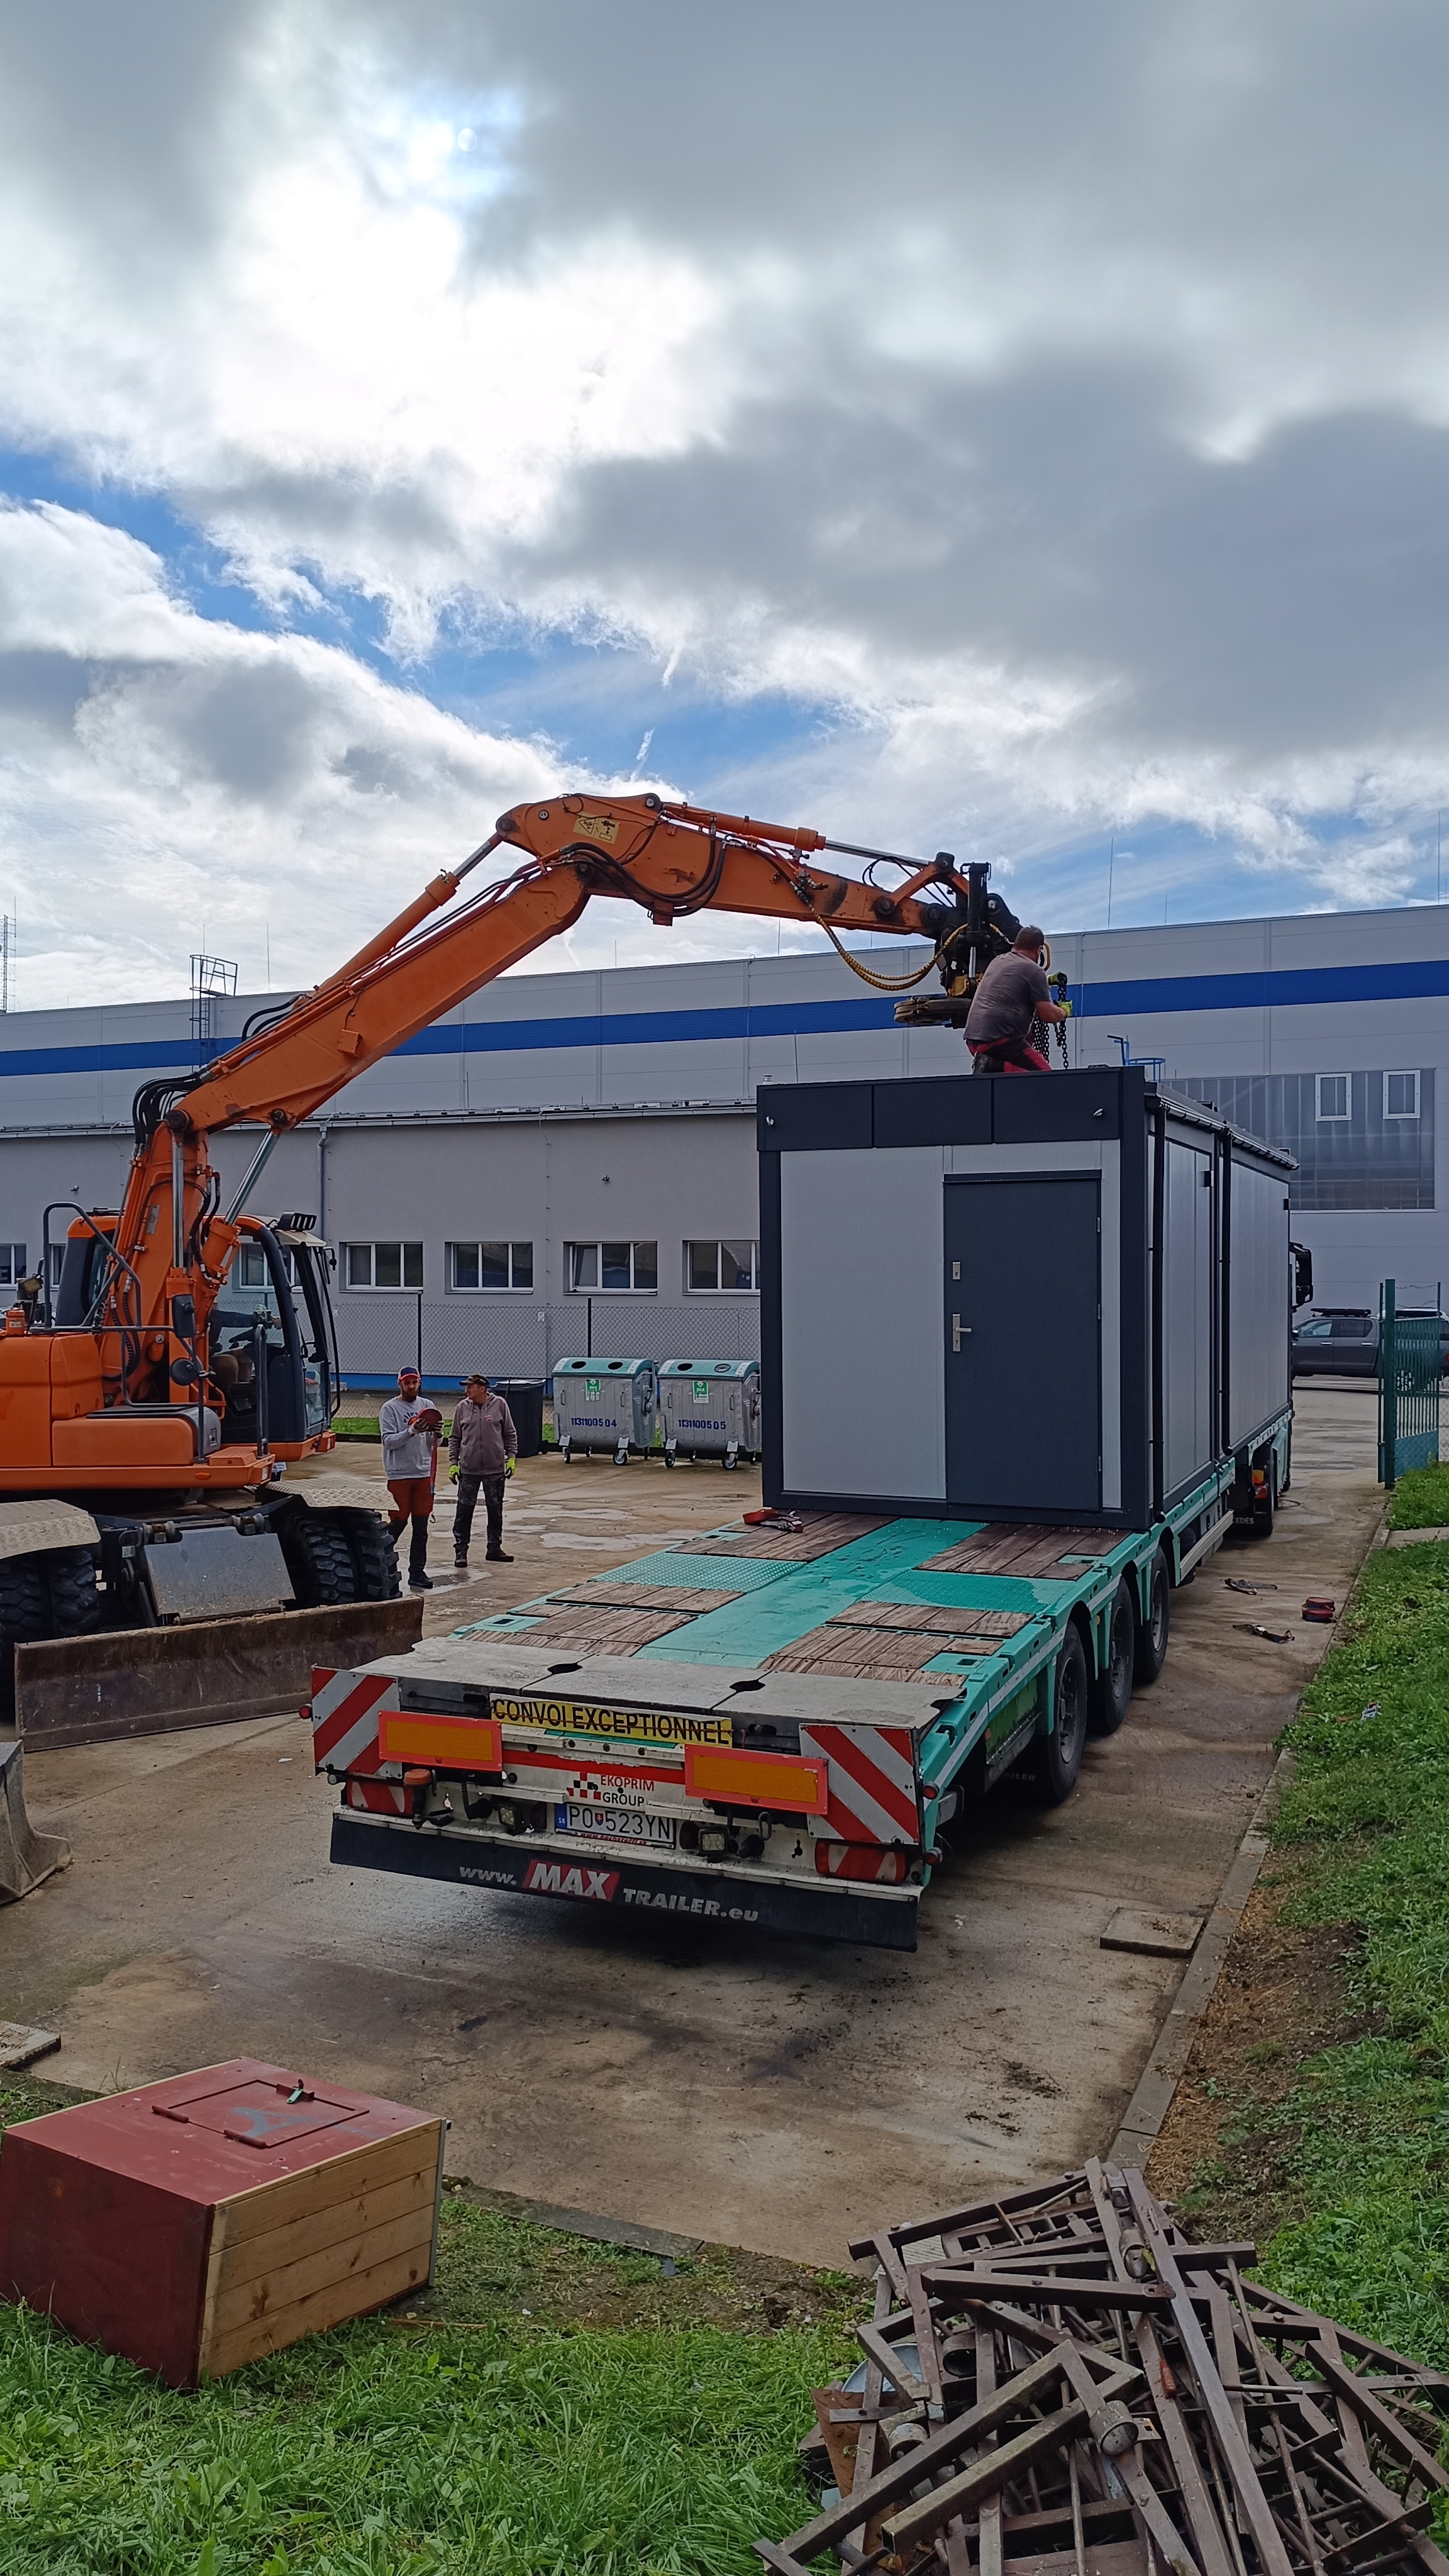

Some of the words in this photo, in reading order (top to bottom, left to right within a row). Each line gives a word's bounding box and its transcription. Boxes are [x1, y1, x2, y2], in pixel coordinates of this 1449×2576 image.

[493, 1698, 567, 1727] CONVOI
[572, 1707, 730, 1745] EXCEPTIONNEL
[601, 1775, 655, 1792] EKOPRIM
[602, 1792, 645, 1807] GROUP
[459, 1866, 518, 1885] www.
[529, 1862, 611, 1900] MAX
[623, 1888, 759, 1921] TRAILER.eu
